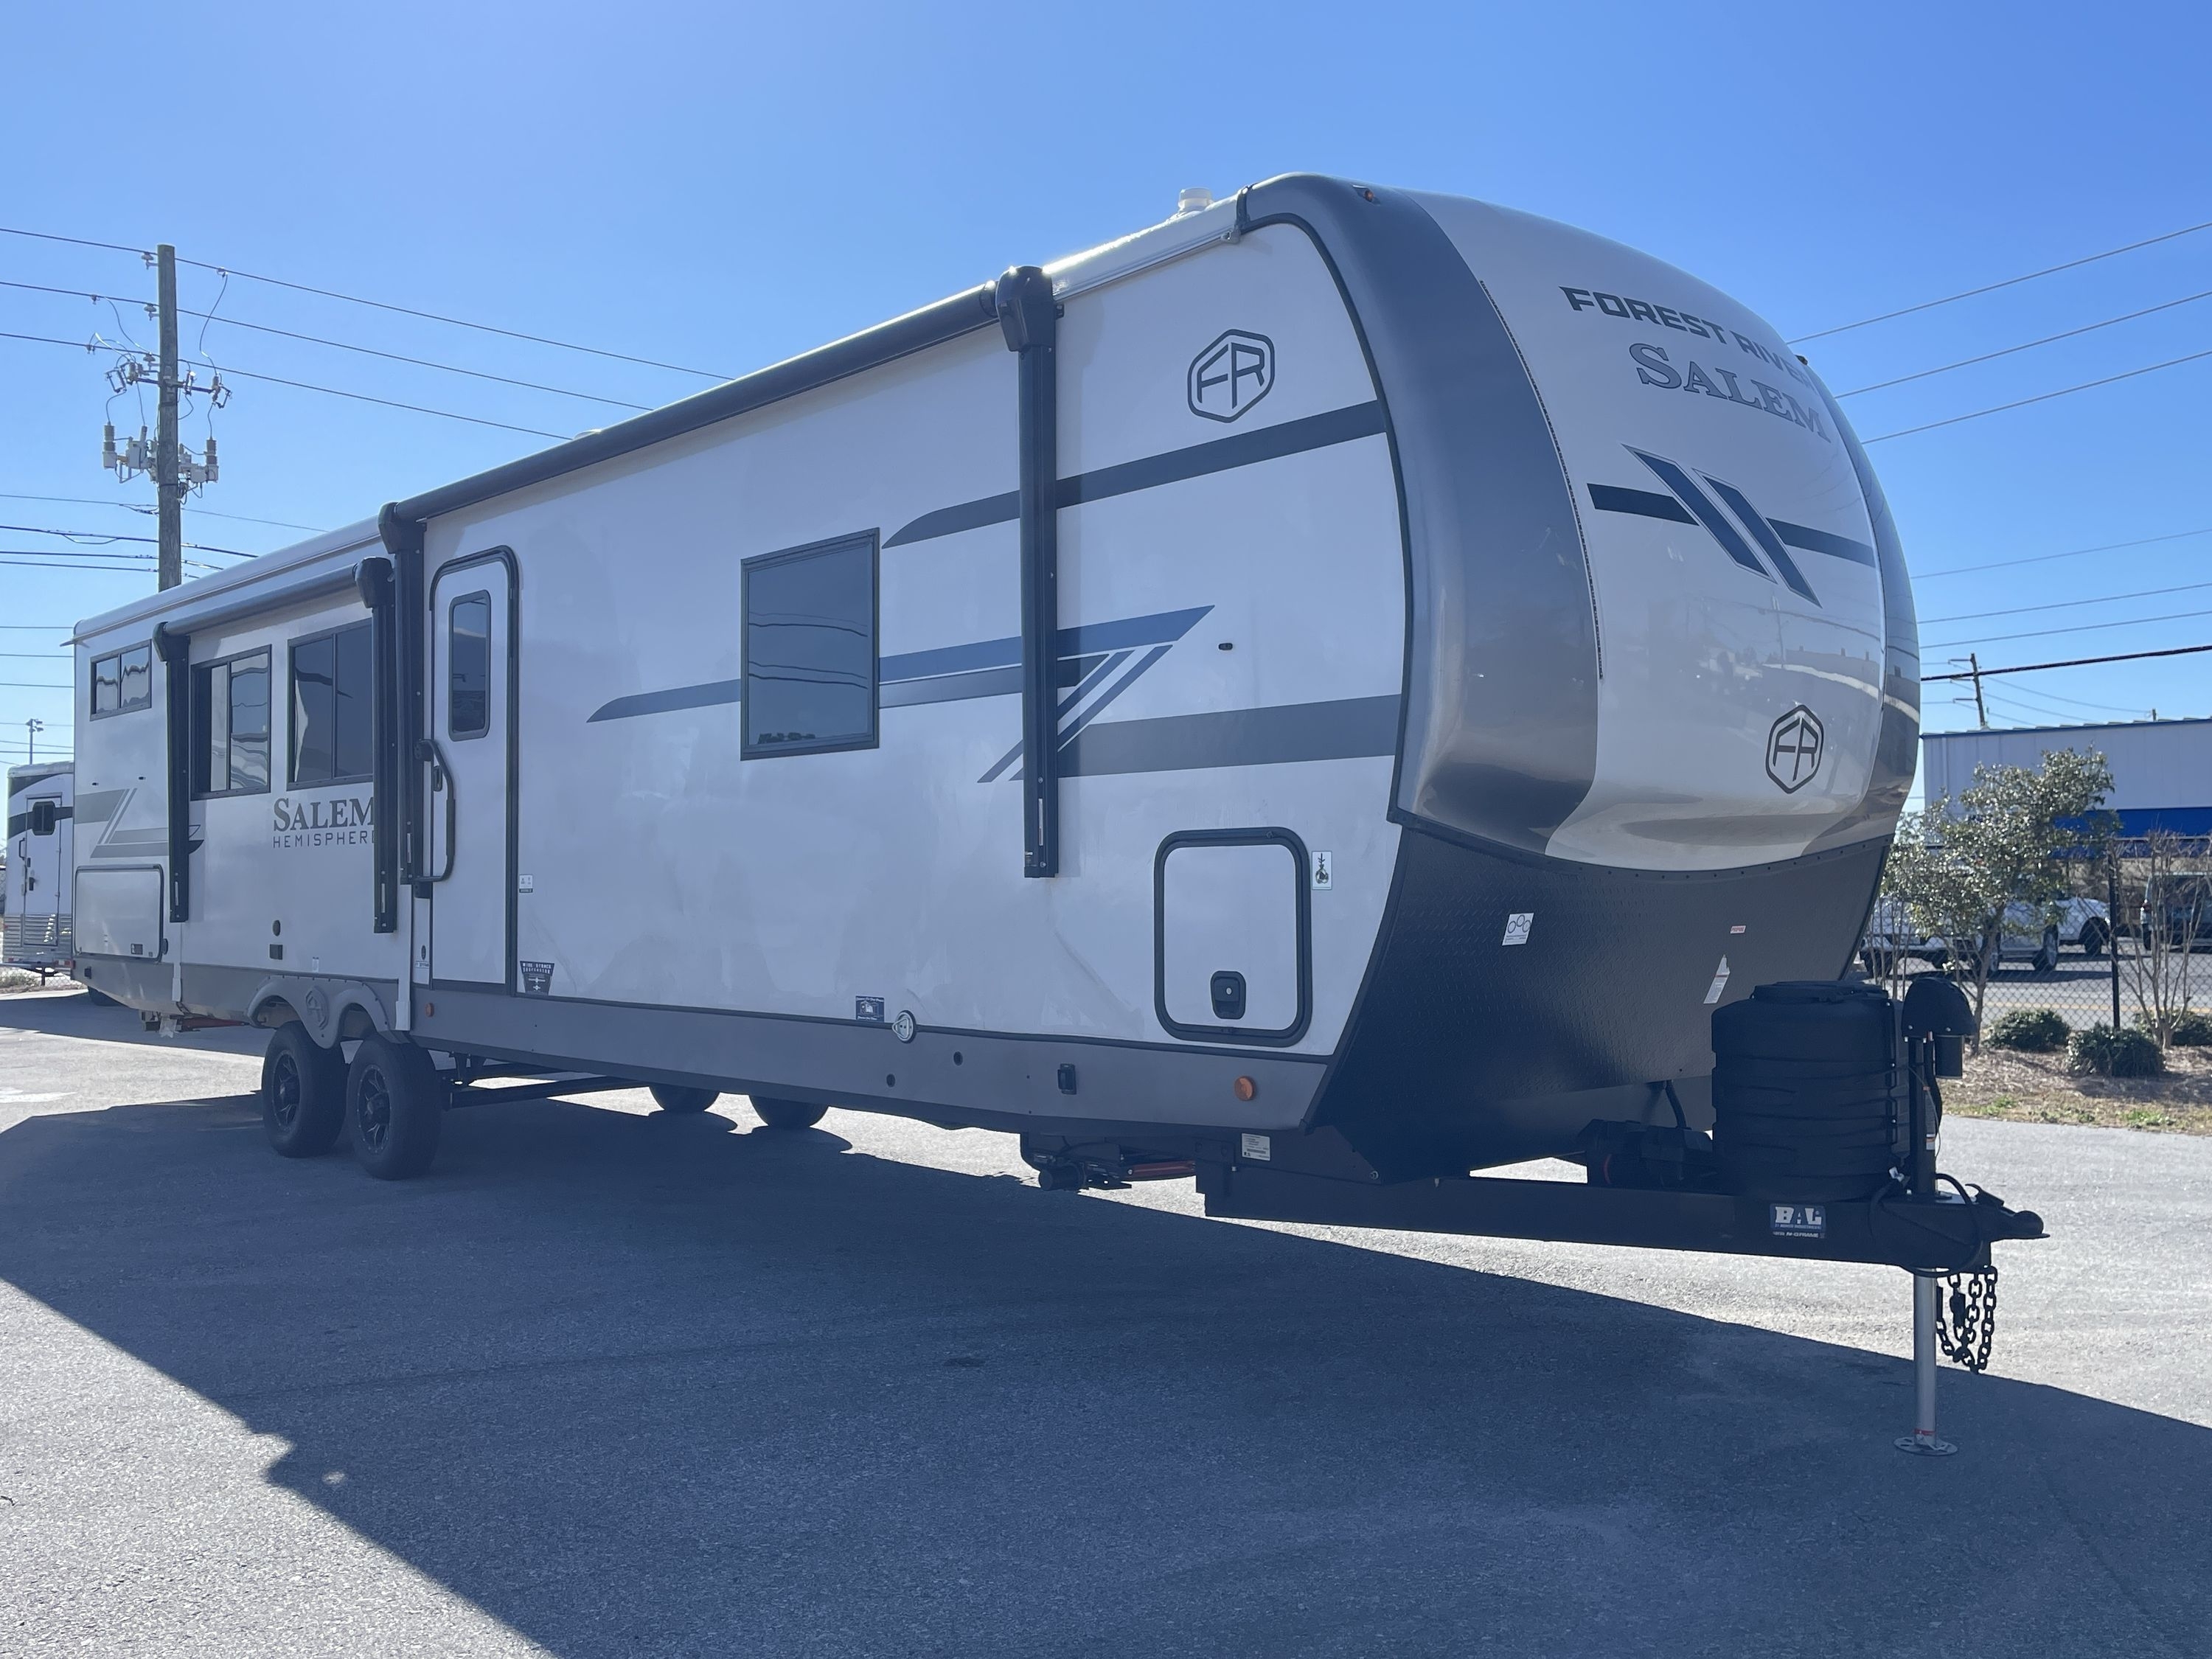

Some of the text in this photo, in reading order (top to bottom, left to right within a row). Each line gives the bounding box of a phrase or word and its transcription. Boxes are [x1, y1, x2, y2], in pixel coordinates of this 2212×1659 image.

[1196, 341, 1265, 410] FR
[1558, 285, 1819, 396] FOREST RIVER
[1628, 342, 1832, 443] SALEM
[273, 797, 375, 832] SALEM
